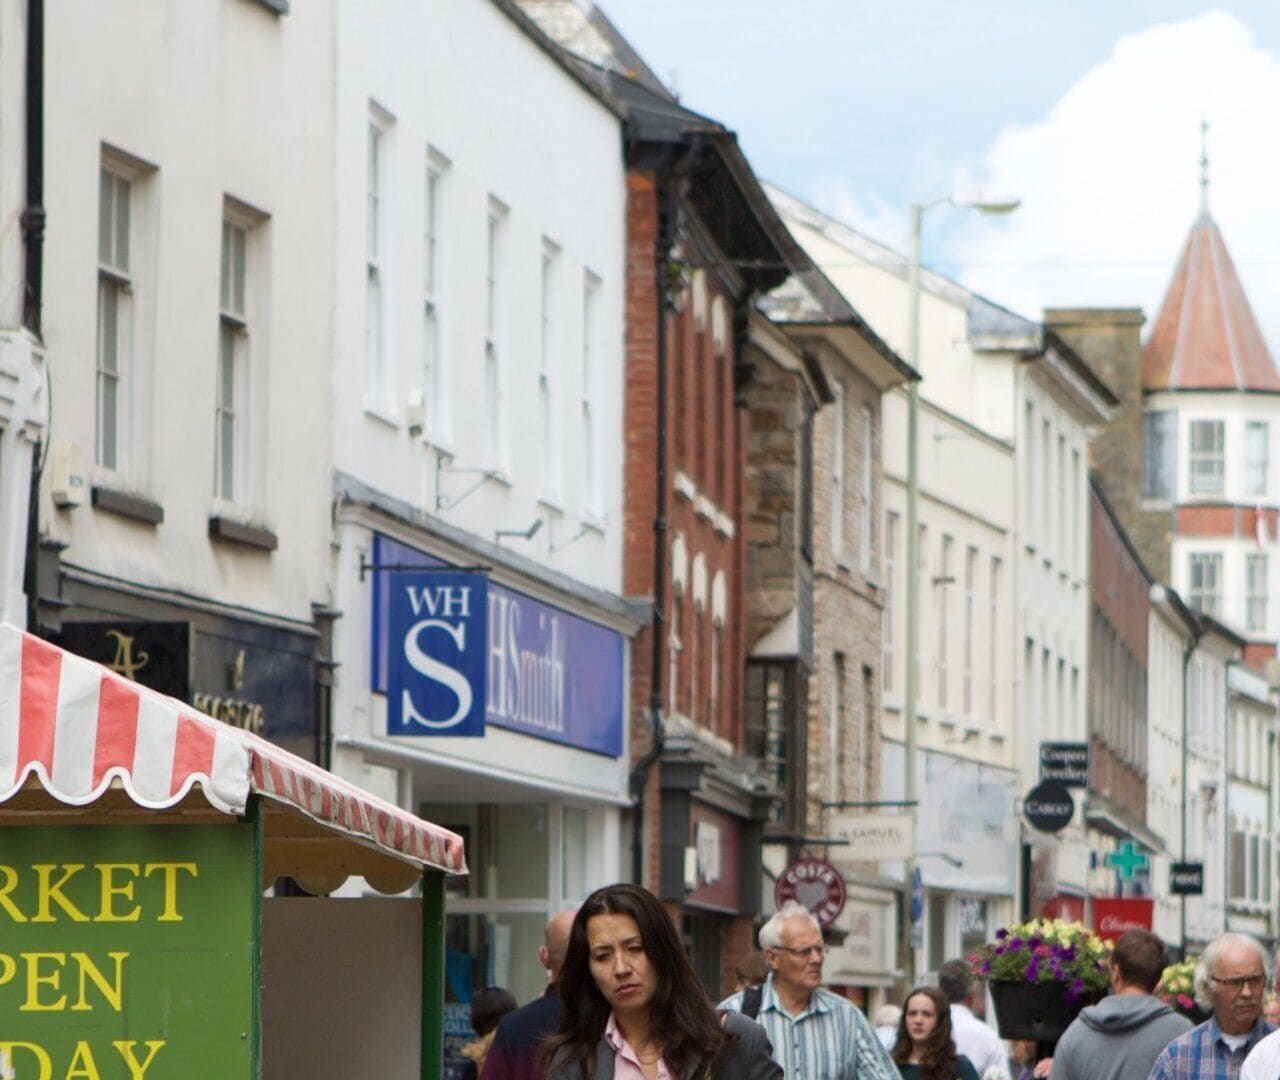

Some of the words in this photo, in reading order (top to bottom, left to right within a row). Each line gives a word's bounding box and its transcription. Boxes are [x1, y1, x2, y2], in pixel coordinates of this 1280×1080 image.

[407, 586, 471, 616] WH
[402, 619, 473, 728] S
[487, 591, 563, 732] HSmith
[786, 863, 833, 885] COSTA
